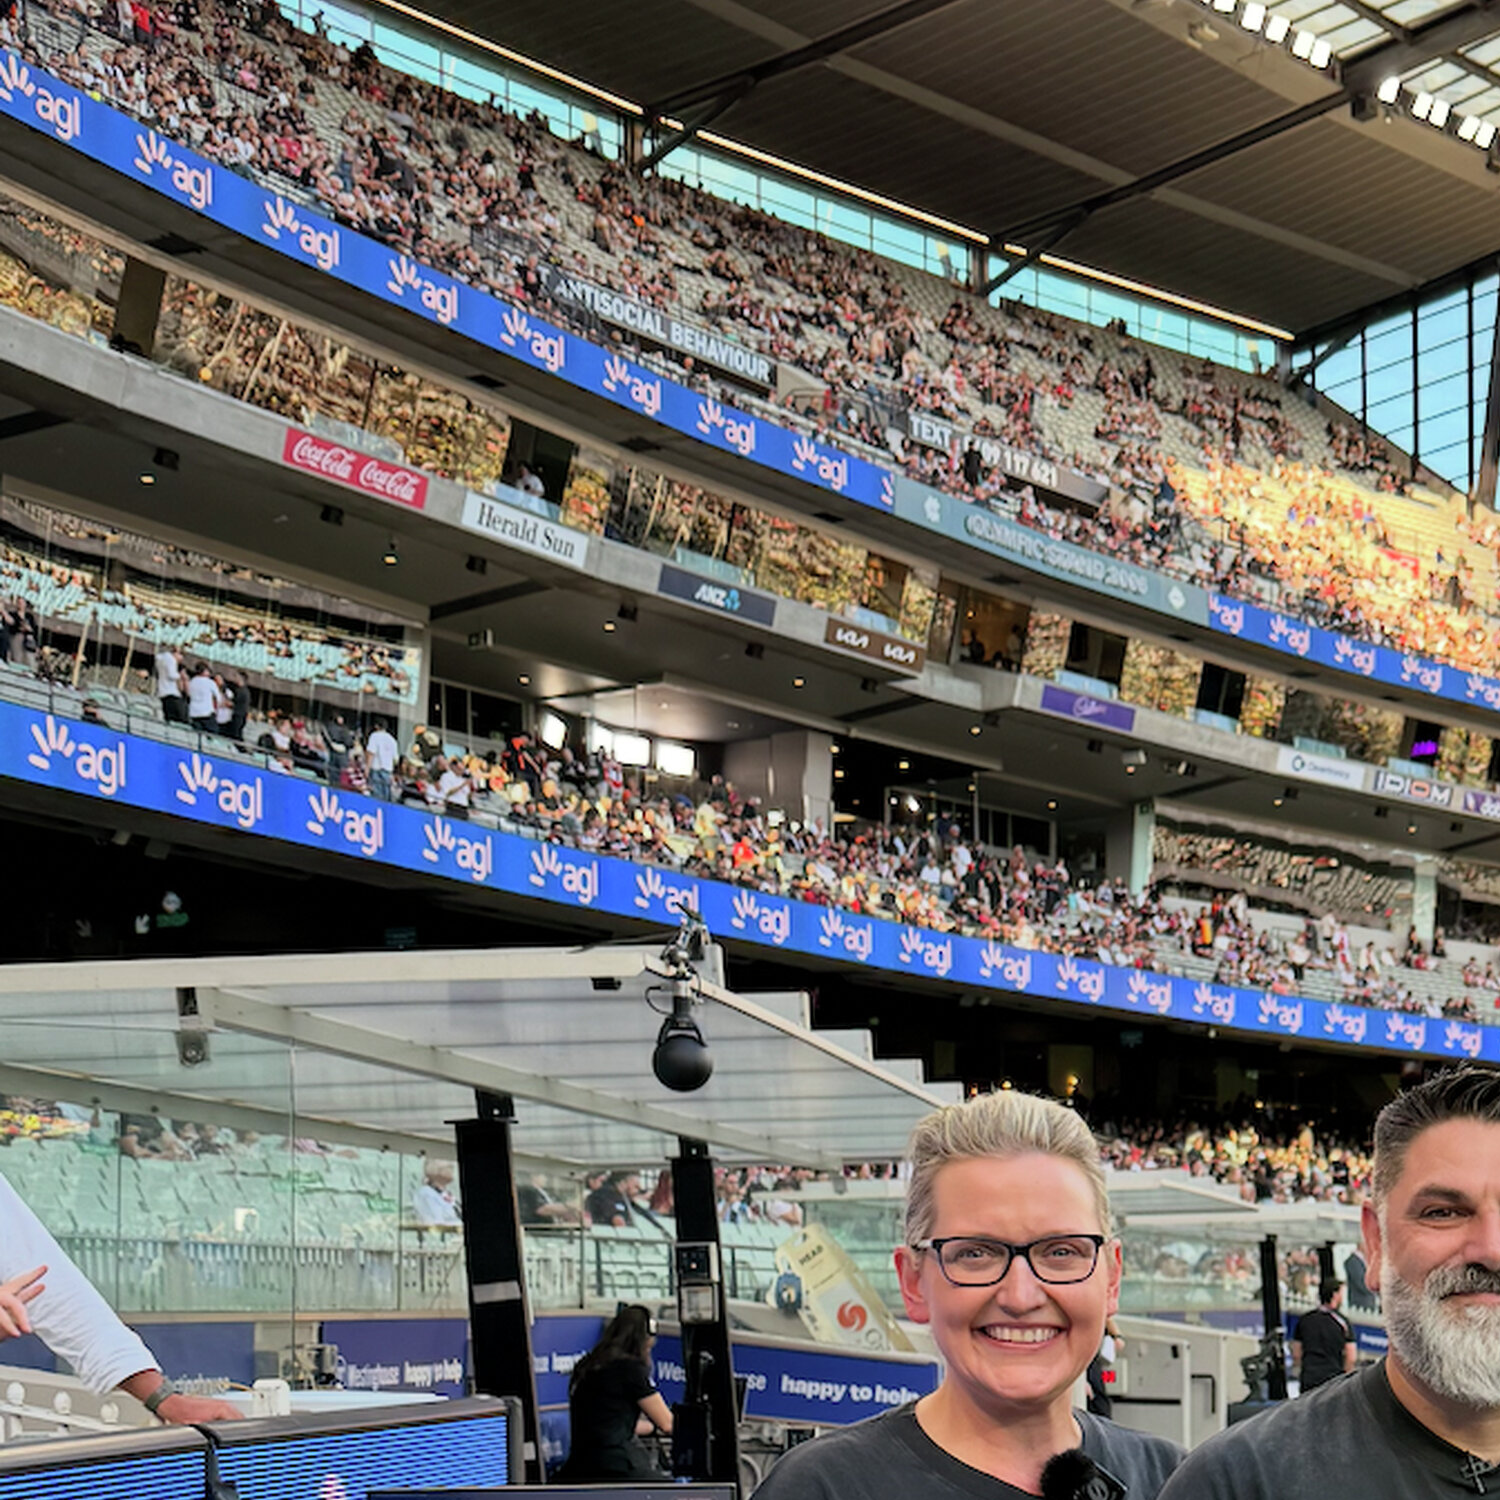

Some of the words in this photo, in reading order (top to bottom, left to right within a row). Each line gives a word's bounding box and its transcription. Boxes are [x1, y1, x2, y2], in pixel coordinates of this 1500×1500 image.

[36, 88, 81, 141] agl
[171, 160, 213, 210] agl
[299, 225, 340, 271] agl
[421, 281, 458, 325] agl
[554, 279, 667, 340] ANTISOCIAL
[670, 321, 771, 383] BEHAVIOUR
[531, 328, 565, 373] agl
[630, 378, 662, 417] agl
[724, 416, 756, 455] agl
[909, 415, 952, 449] TEXT
[818, 456, 848, 491] agl
[477, 501, 536, 545] Herald
[541, 532, 575, 559] Sun
[694, 584, 728, 609] ANZ
[1220, 603, 1244, 635] agl
[835, 627, 869, 649] KIA
[883, 642, 916, 665] KIA
[1288, 627, 1311, 656] agl
[1352, 647, 1376, 676] agl
[1420, 665, 1443, 693] agl
[76, 742, 126, 796] agl
[217, 777, 263, 829] agl
[1377, 770, 1451, 805] IDIOM
[344, 809, 384, 857] agl
[456, 836, 492, 882] agl
[562, 861, 598, 905] agl
[758, 905, 790, 944] agl
[843, 923, 873, 961] agl
[923, 940, 952, 976] agl
[1004, 955, 1031, 990] agl
[1079, 969, 1105, 1002] agl
[1149, 981, 1172, 1014] agl
[1211, 994, 1235, 1024] agl
[1278, 1004, 1303, 1033] agl
[1343, 1013, 1367, 1042] agl
[1403, 1022, 1426, 1050] agl
[1460, 1029, 1482, 1057] agl
[404, 1359, 432, 1388] happy
[780, 1373, 846, 1402] happy
[849, 1386, 873, 1402] to
